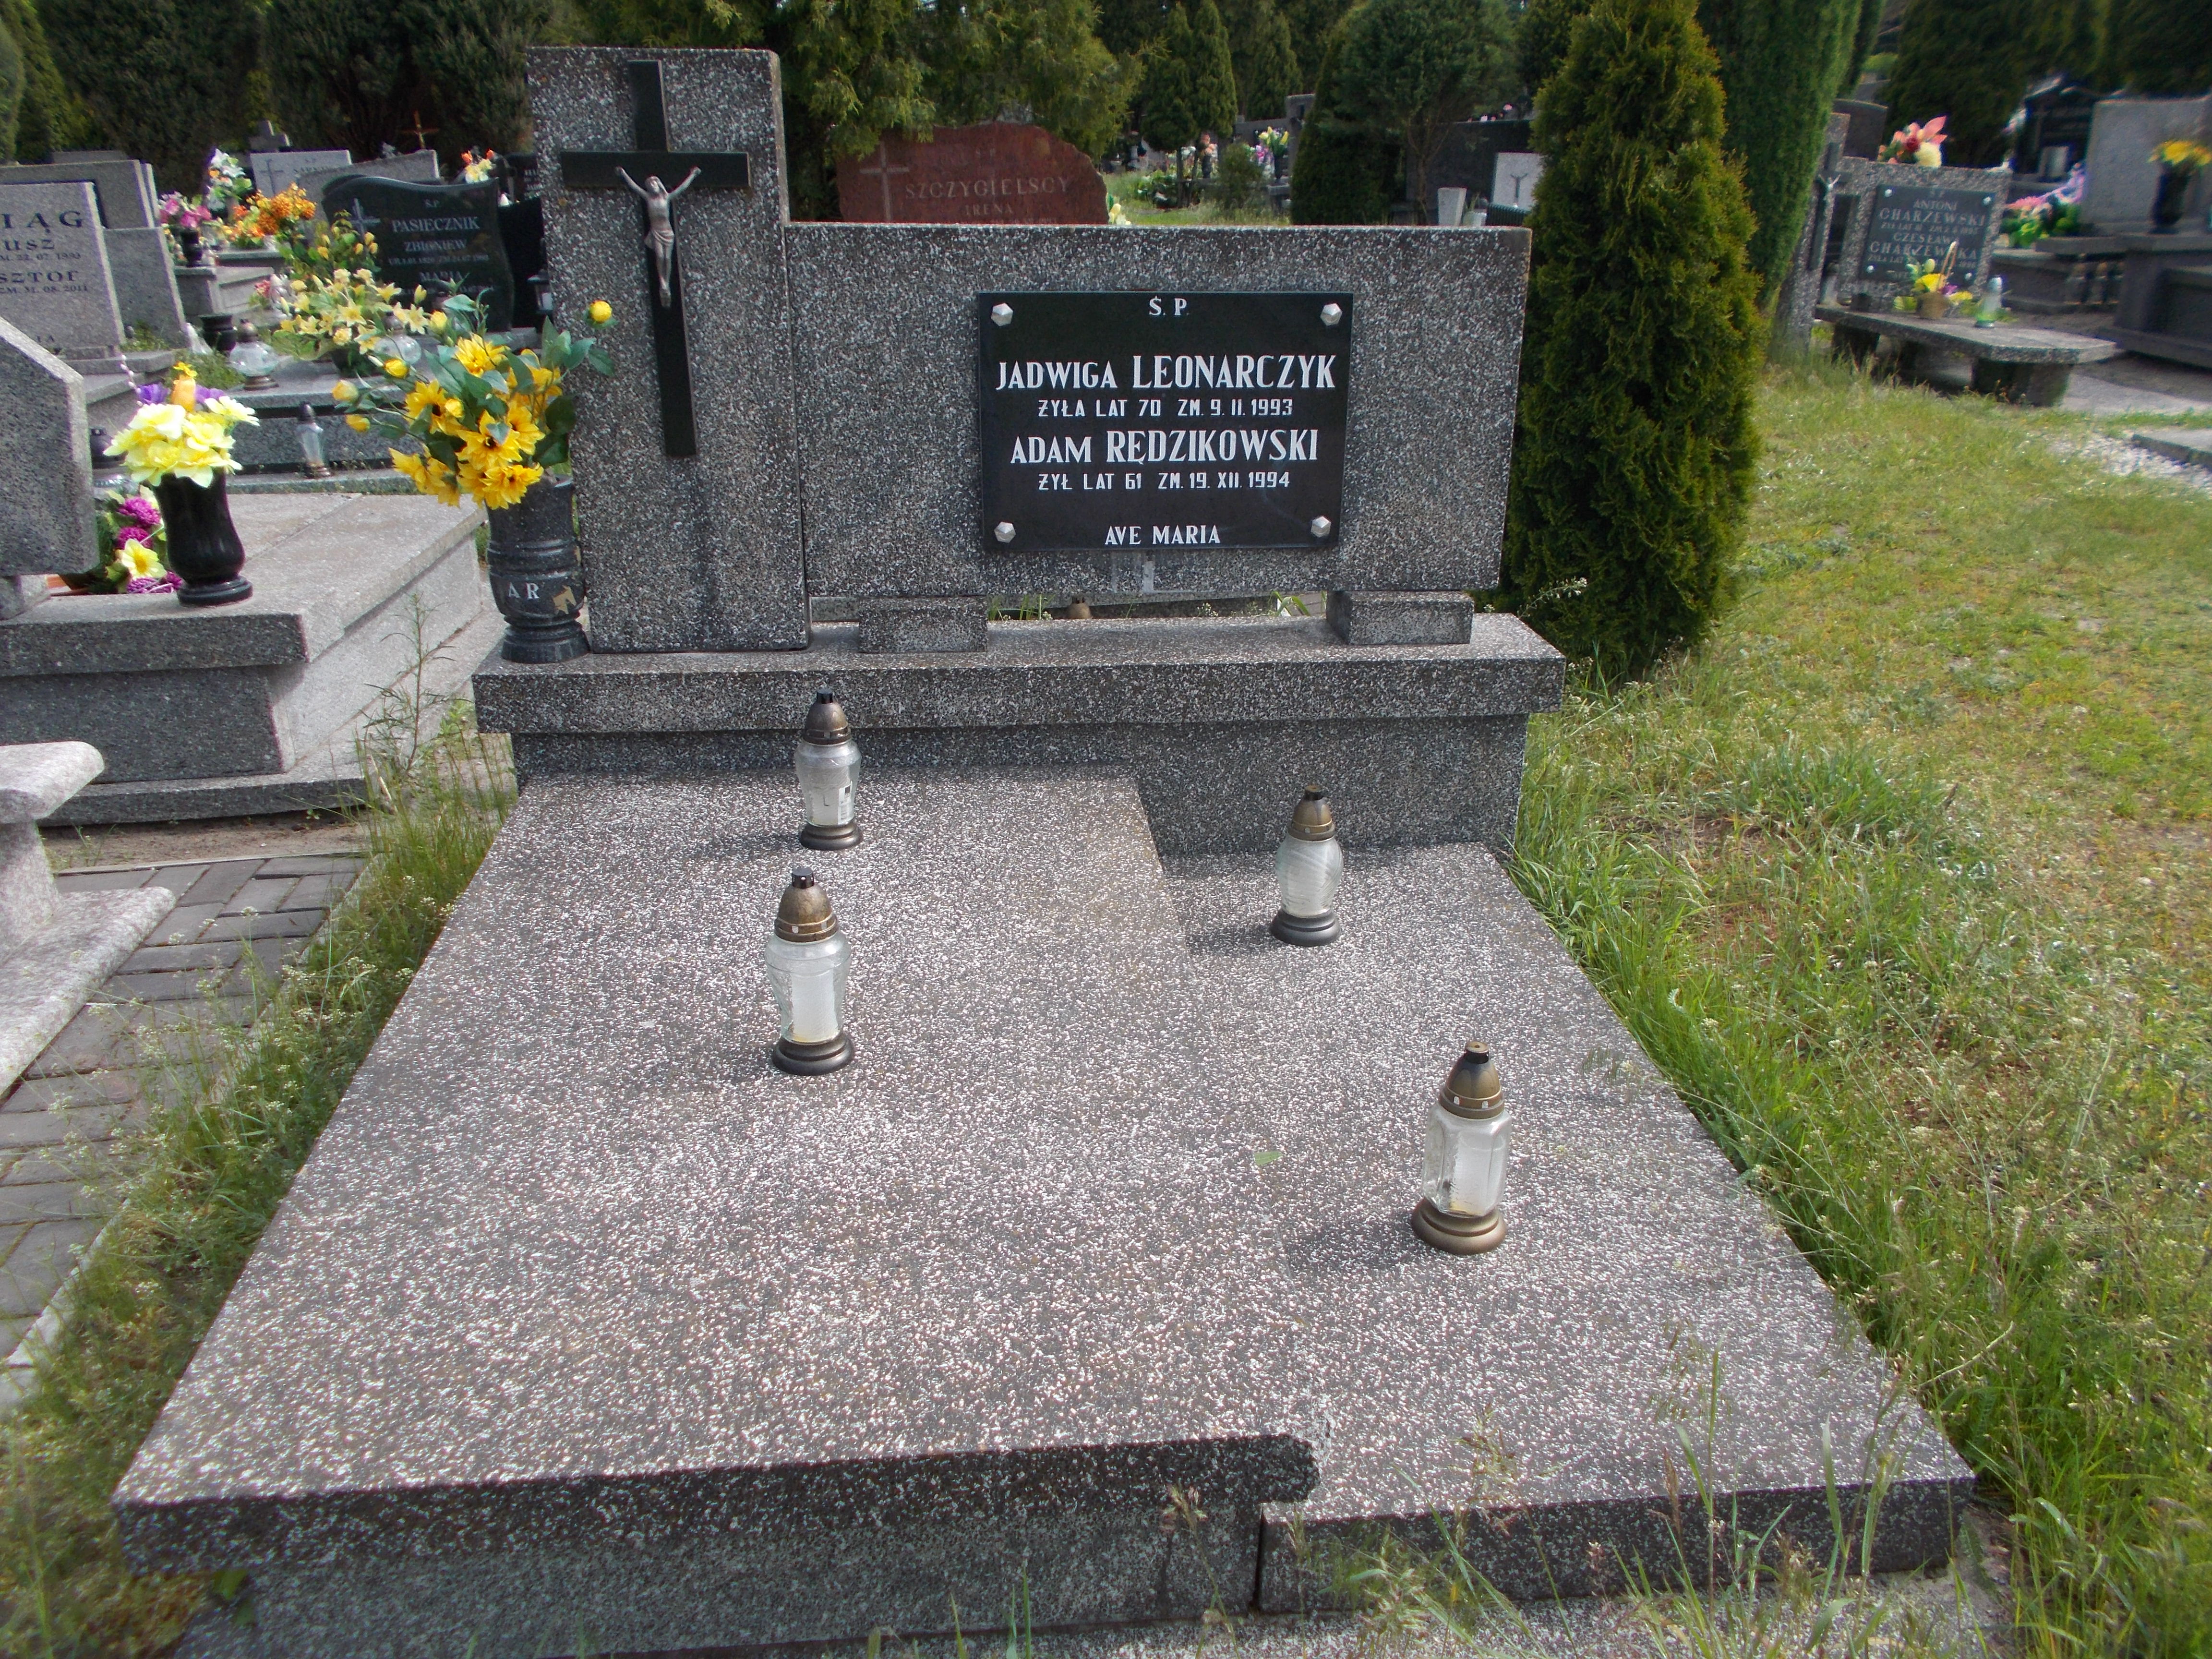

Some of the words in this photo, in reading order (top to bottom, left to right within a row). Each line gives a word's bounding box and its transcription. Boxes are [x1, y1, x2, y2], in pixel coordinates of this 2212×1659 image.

[905, 177, 1070, 199] SZCZYGIELSCY
[965, 204, 1015, 216] IRENA
[1913, 199, 1958, 211] ANTONI
[392, 216, 480, 232] PASIECZNIK
[1879, 207, 1987, 227] CHARZEWSKI
[404, 239, 466, 252] ZBIGNIEW
[1870, 241, 1977, 259] CHARZEWKA
[996, 361, 1118, 390] JADWIGA
[1132, 354, 1336, 388] LEONARCZYK
[1095, 399, 1128, 417] LAT
[1138, 399, 1161, 417] 70
[1178, 399, 1204, 416] ZM.
[1251, 398, 1293, 416] 1993
[1010, 435, 1092, 464] ADAM
[1106, 429, 1319, 465] RĘDZIKOWSKI
[1083, 473, 1115, 490] LAT
[1125, 473, 1142, 489] 61
[1158, 472, 1184, 489] ZM.
[1189, 472, 1211, 489] 19.
[1248, 471, 1290, 488] 1994
[1105, 526, 1142, 546] AVE
[1152, 524, 1221, 544] MARIA
